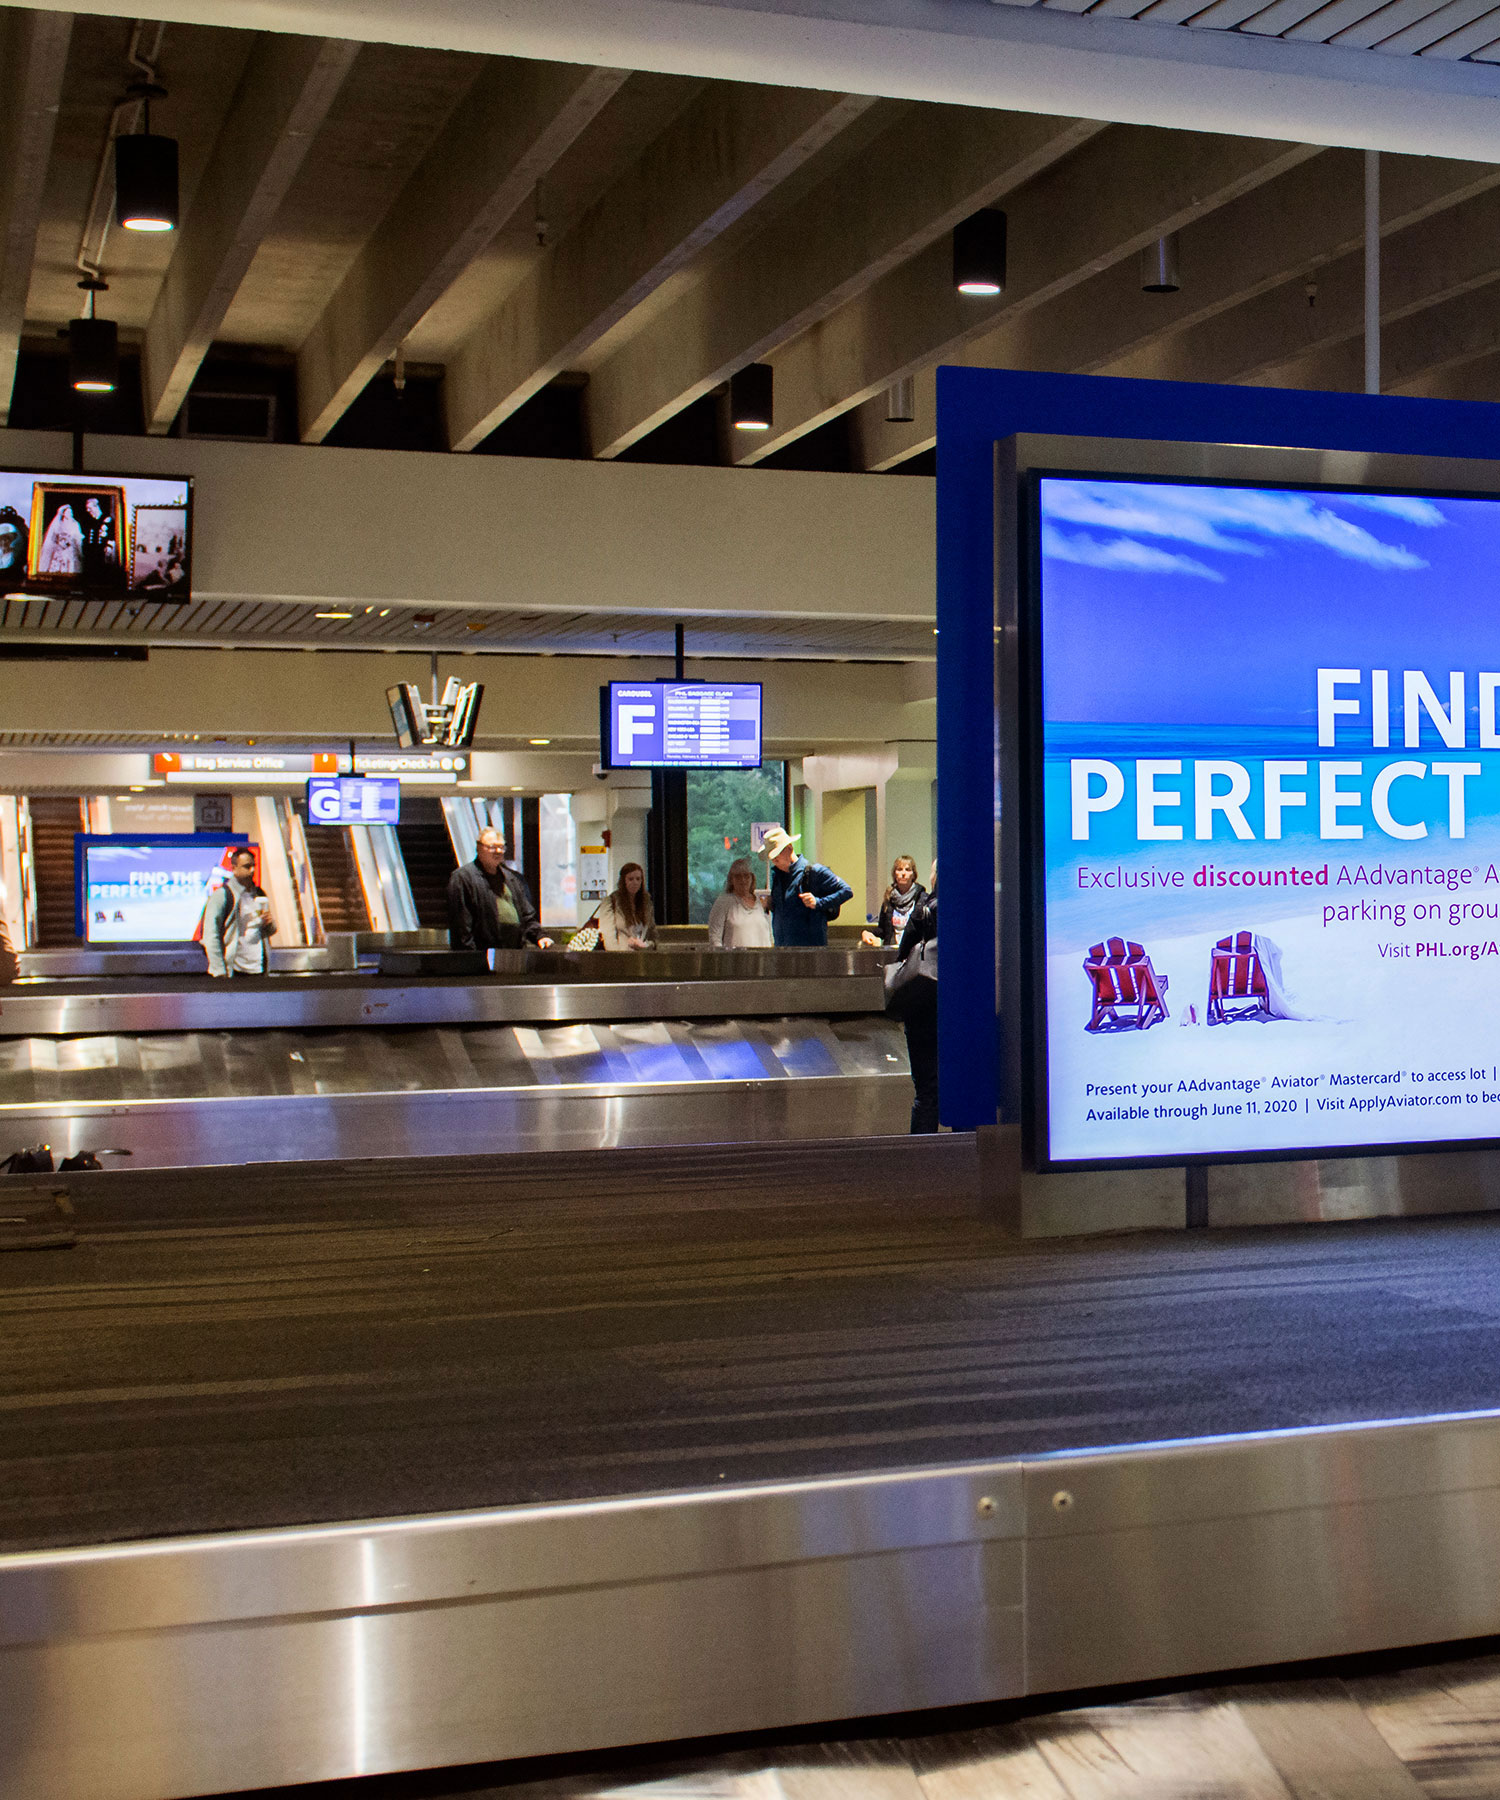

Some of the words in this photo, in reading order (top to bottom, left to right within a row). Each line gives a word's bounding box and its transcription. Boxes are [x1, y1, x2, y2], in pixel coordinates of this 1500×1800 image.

[618, 705, 656, 754] F
[195, 757, 216, 770] Bag
[216, 757, 252, 769] Service
[252, 757, 285, 769] Office
[311, 788, 340, 819] G
[1070, 759, 1482, 841] PERFECT
[129, 871, 168, 885] FIND
[171, 870, 202, 885] THE
[1078, 866, 1185, 889] Exclusive
[1193, 864, 1329, 887] discounted
[89, 884, 159, 898] PERFECT
[161, 884, 203, 898] SPOT
[1322, 899, 1406, 927] parking
[1413, 903, 1442, 920] on
[1378, 942, 1411, 958] Visit
[1086, 1083, 1137, 1096] Present
[1142, 1082, 1173, 1098] your
[1411, 1071, 1424, 1083] to
[1427, 1070, 1466, 1082] access
[1470, 1068, 1486, 1081] lot
[1086, 1106, 1150, 1122] Available
[1154, 1103, 1208, 1121] through
[1211, 1102, 1242, 1116] June
[1246, 1101, 1261, 1115] 11,
[1264, 1100, 1298, 1114] 2020
[1316, 1097, 1345, 1110] Visit
[1348, 1093, 1462, 1112] ApplyAviator.com
[1465, 1092, 1479, 1104] to
